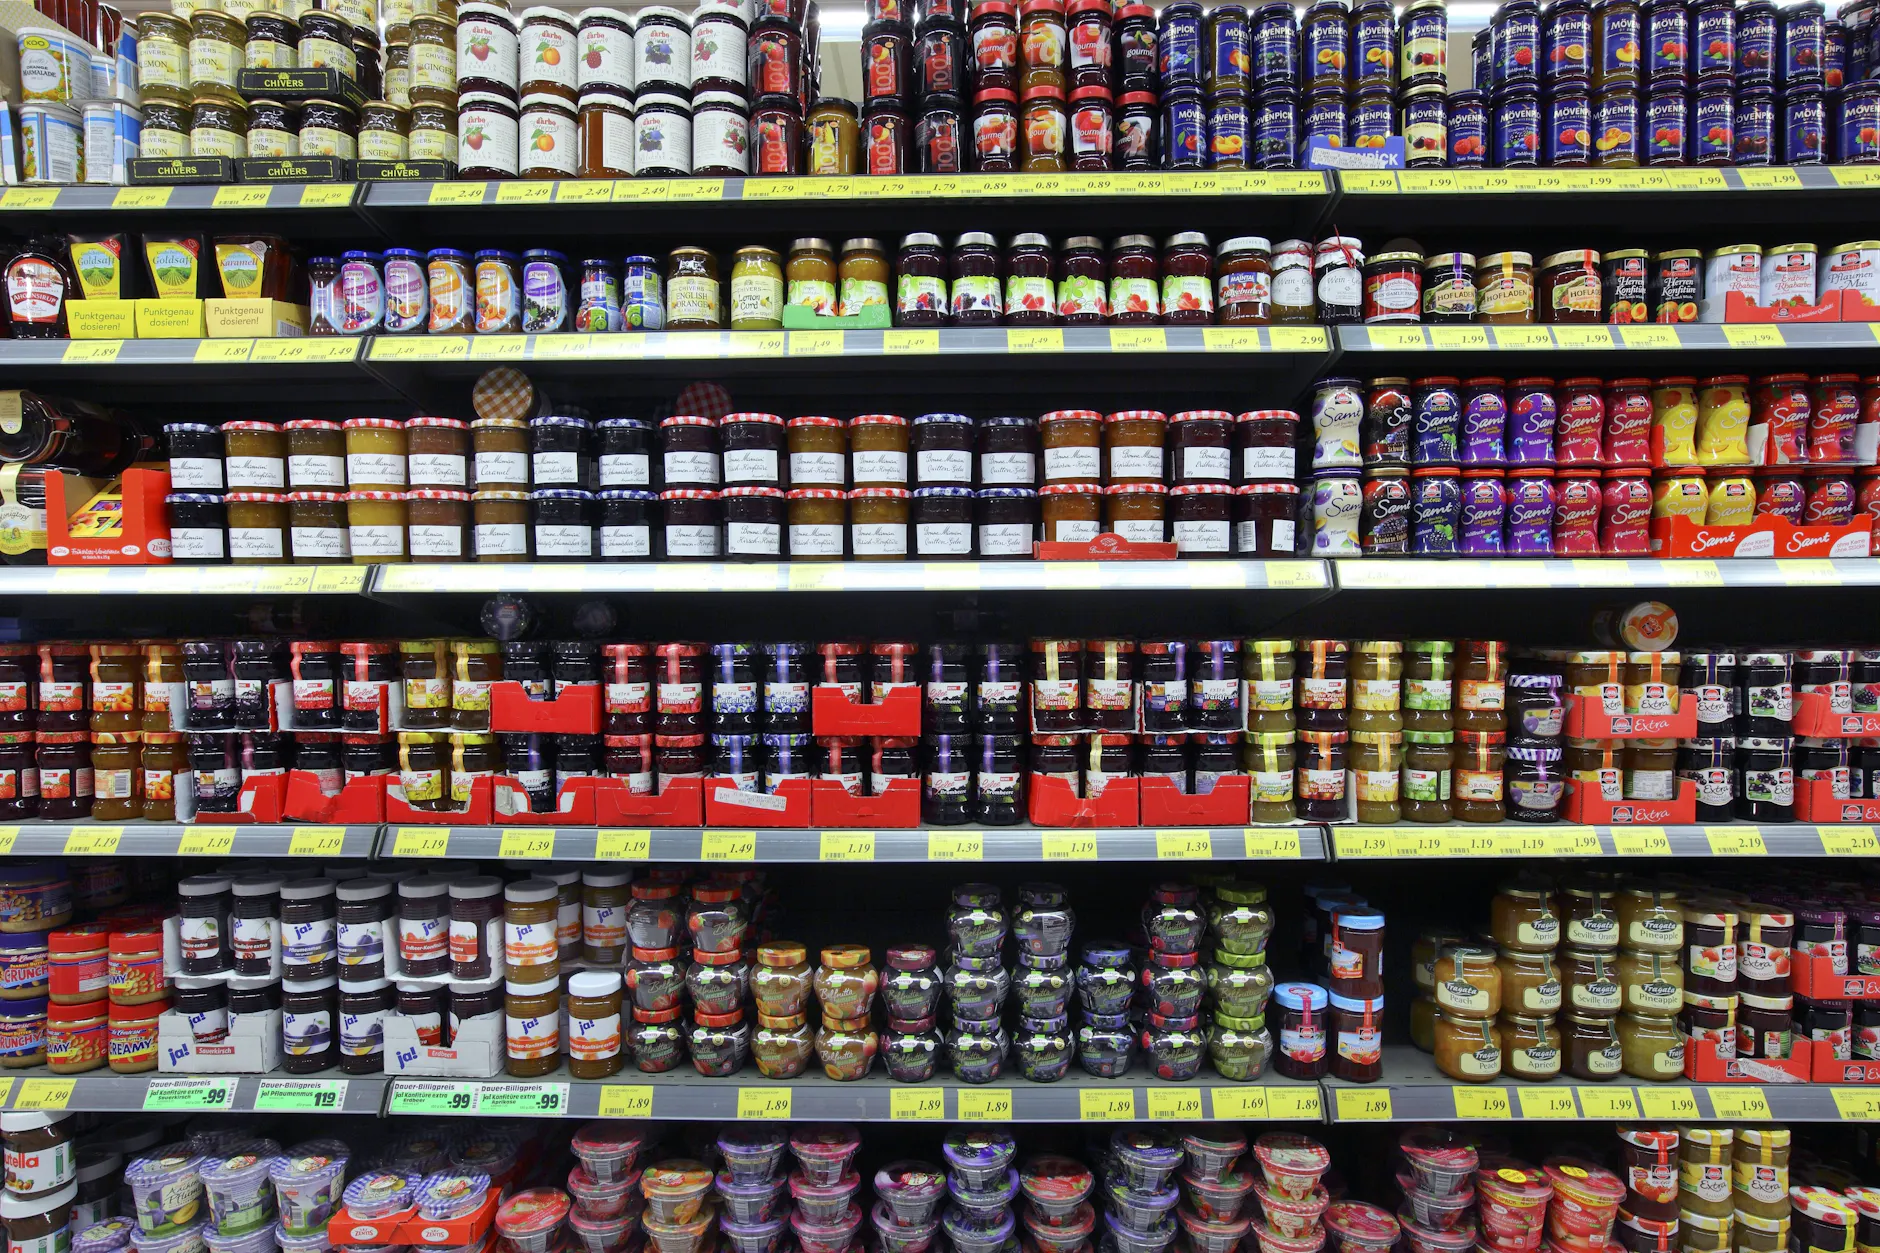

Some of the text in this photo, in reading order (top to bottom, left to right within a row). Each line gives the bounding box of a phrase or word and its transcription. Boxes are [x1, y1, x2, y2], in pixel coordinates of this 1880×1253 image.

[22, 69, 57, 78] MARMALADE
[424, 64, 456, 75] GINGER
[264, 79, 304, 88] CHIVERS
[877, 64, 891, 93] 100
[820, 143, 834, 174] 100
[877, 144, 891, 174] 100
[158, 166, 197, 175] CHIVERS
[268, 168, 308, 176] CHIVERS
[381, 169, 420, 177] CHIVERS
[983, 182, 1007, 190] 0.89
[1035, 181, 1059, 189] 0.89
[1087, 181, 1110, 189] 0.89
[1138, 180, 1161, 188] 0.89
[458, 189, 482, 198] 2.49
[524, 188, 548, 196] 2.49
[585, 187, 609, 196] 2.49
[641, 186, 665, 195] 2.49
[696, 186, 720, 194] 2.49
[78, 255, 115, 266] Goldsaft
[152, 255, 193, 266] Goldsaft
[220, 258, 258, 267] Karamell
[1664, 277, 1694, 286] Herren
[1828, 272, 1873, 284] Pflaumen
[1843, 279, 1868, 289] Mus
[1437, 290, 1475, 301] HOFLADEN
[1486, 289, 1527, 301] HOFLADEN
[1661, 285, 1696, 296] Konfitüre
[143, 308, 194, 317] Punktgenau
[214, 306, 264, 316] Punktgenau
[74, 311, 126, 322] Punktgenau
[220, 317, 259, 326] dosieren!
[80, 322, 120, 331] dosieren!
[150, 317, 189, 327] dosieren!
[1300, 336, 1323, 344] 2.99
[279, 348, 302, 356] 1.49
[328, 347, 352, 355] 1.49
[440, 346, 464, 354] 1.49
[1320, 406, 1361, 427] Samt
[1416, 411, 1458, 434] Samt
[1464, 413, 1506, 434] Samt
[1558, 413, 1600, 435] Samt
[1374, 500, 1411, 518] Samt
[1461, 504, 1502, 525] Samt
[1509, 504, 1551, 525] Samt
[1554, 506, 1596, 526] Samt
[1691, 531, 1735, 552] Samt
[1787, 532, 1830, 553] Samt
[1641, 700, 1670, 710] Extra
[1698, 702, 1731, 712] Extra
[1634, 719, 1669, 733] Extra
[1635, 810, 1670, 822] Extra
[92, 837, 116, 847] 1.19
[206, 837, 230, 847] 1.19
[317, 839, 340, 848] 1.19
[422, 839, 444, 849] 1.19
[527, 841, 550, 851] 1.39
[623, 842, 645, 851] 1.19
[1071, 842, 1094, 852] 1.19
[1186, 842, 1207, 851] 1.39
[1274, 841, 1295, 850] 1.19
[1363, 840, 1385, 849] 1.39
[1418, 839, 1440, 849] 1.19
[1471, 839, 1493, 848] 1.19
[1522, 839, 1544, 848] 1.19
[1574, 838, 1596, 847] 1.99
[1644, 839, 1666, 848] 1.99
[1738, 838, 1761, 848] 2.19
[1851, 839, 1874, 848] 2.19
[729, 843, 752, 853] 1.49
[848, 843, 870, 853] 1.19
[956, 843, 979, 853] 1.39
[597, 908, 613, 923] ja!
[422, 919, 440, 936] ja!
[1583, 919, 1614, 929] Fragata
[1644, 920, 1676, 929] Fragata
[294, 922, 313, 940] ja!
[516, 924, 533, 940] ja!
[1573, 931, 1596, 939] Seville
[1640, 929, 1678, 940] Pineapple
[1742, 958, 1772, 968] Extra
[4, 965, 48, 982] CRUNCH
[1444, 984, 1478, 995] Fragata
[1643, 984, 1675, 993] Fragata
[1450, 995, 1472, 1005] Peach
[1578, 994, 1601, 1002] Seville
[1639, 993, 1678, 1004] Pineapple
[522, 1018, 539, 1035] ja!
[578, 1020, 595, 1036] ja!
[109, 1039, 152, 1055] CREAMY
[168, 1044, 190, 1066] ja!
[396, 1046, 418, 1069] ja!
[1528, 1048, 1556, 1057] Fragata
[1528, 1059, 1556, 1069] Apricot
[150, 1080, 211, 1088] Dauer-Billigpreis
[44, 1091, 68, 1102] 1.99
[627, 1098, 649, 1109] 1.89
[766, 1100, 787, 1111] 1.89
[919, 1099, 941, 1111] 1.89
[986, 1101, 1008, 1112] 1.89
[1108, 1101, 1130, 1112] 1.89
[1177, 1100, 1199, 1111] 1.89
[1242, 1098, 1264, 1109] 1.69
[1296, 1099, 1318, 1110] 1.89
[1366, 1101, 1387, 1112] 1.89
[1483, 1100, 1506, 1111] 1.99
[1550, 1100, 1572, 1110] 1.99
[1610, 1100, 1632, 1110] 1.99
[1671, 1100, 1693, 1111] 1.99
[1742, 1101, 1764, 1111] 1.99
[4, 1152, 38, 1169] utella
[1700, 1180, 1726, 1190] Extra
[1751, 1180, 1780, 1191] Extra
